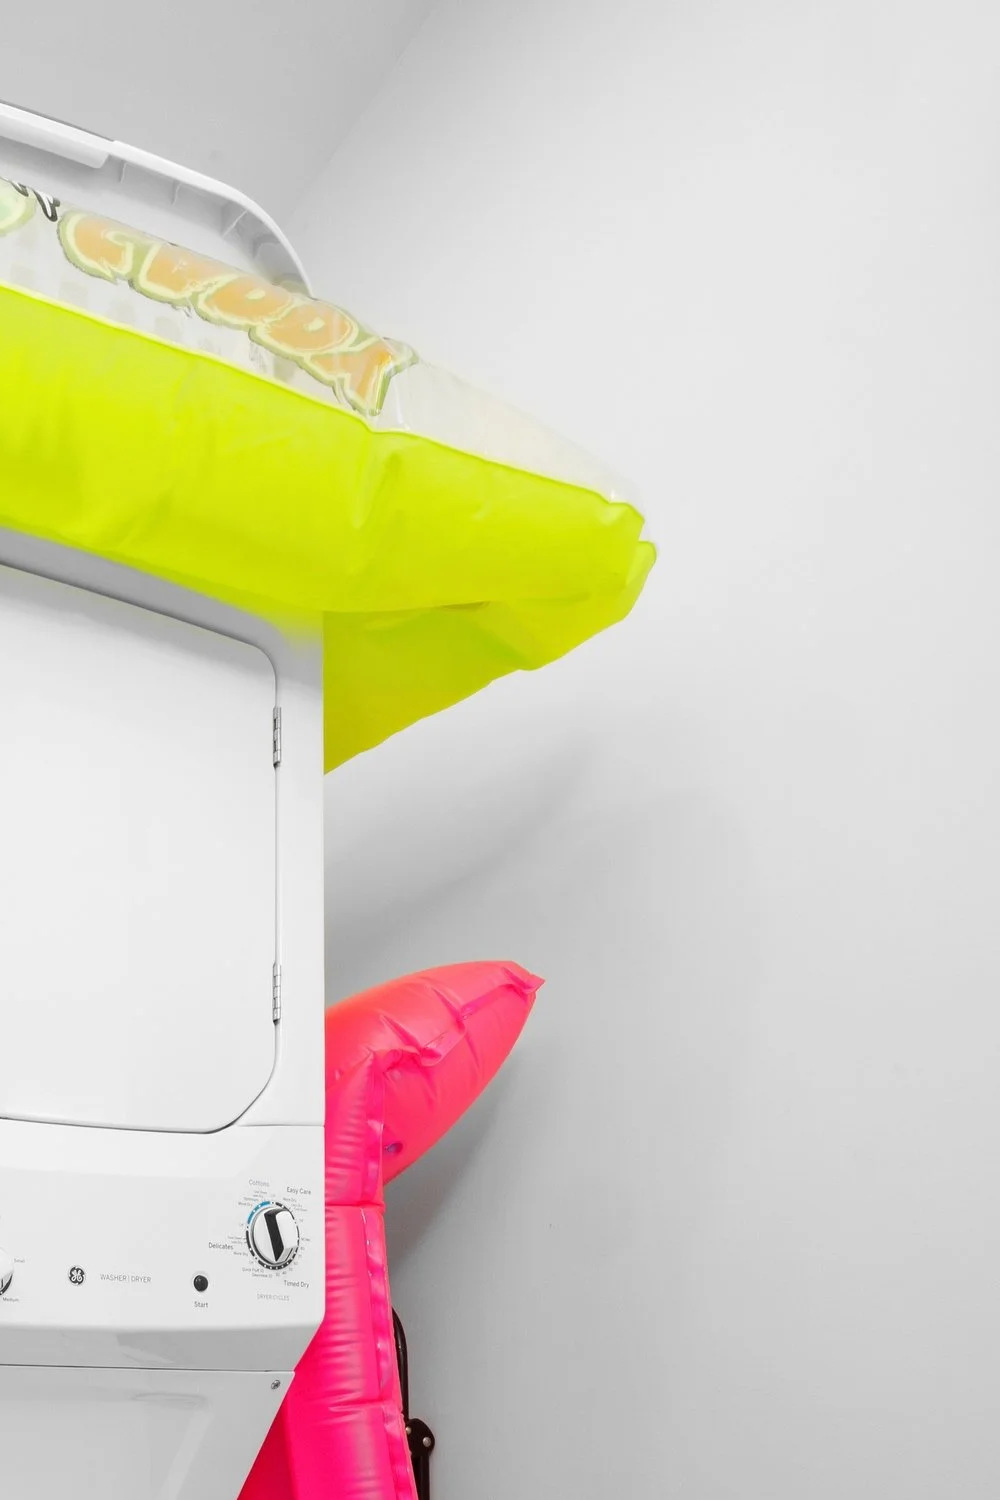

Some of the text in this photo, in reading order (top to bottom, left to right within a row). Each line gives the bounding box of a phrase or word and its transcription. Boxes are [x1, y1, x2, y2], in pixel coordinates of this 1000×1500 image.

[248, 1179, 270, 1188] Cottons
[286, 1186, 298, 1195] Easy
[208, 1242, 234, 1250] Delicates
[100, 1273, 151, 1284] WASHER DRYER
[284, 1279, 310, 1291] Timed Dry
[193, 1301, 209, 1309] Start
